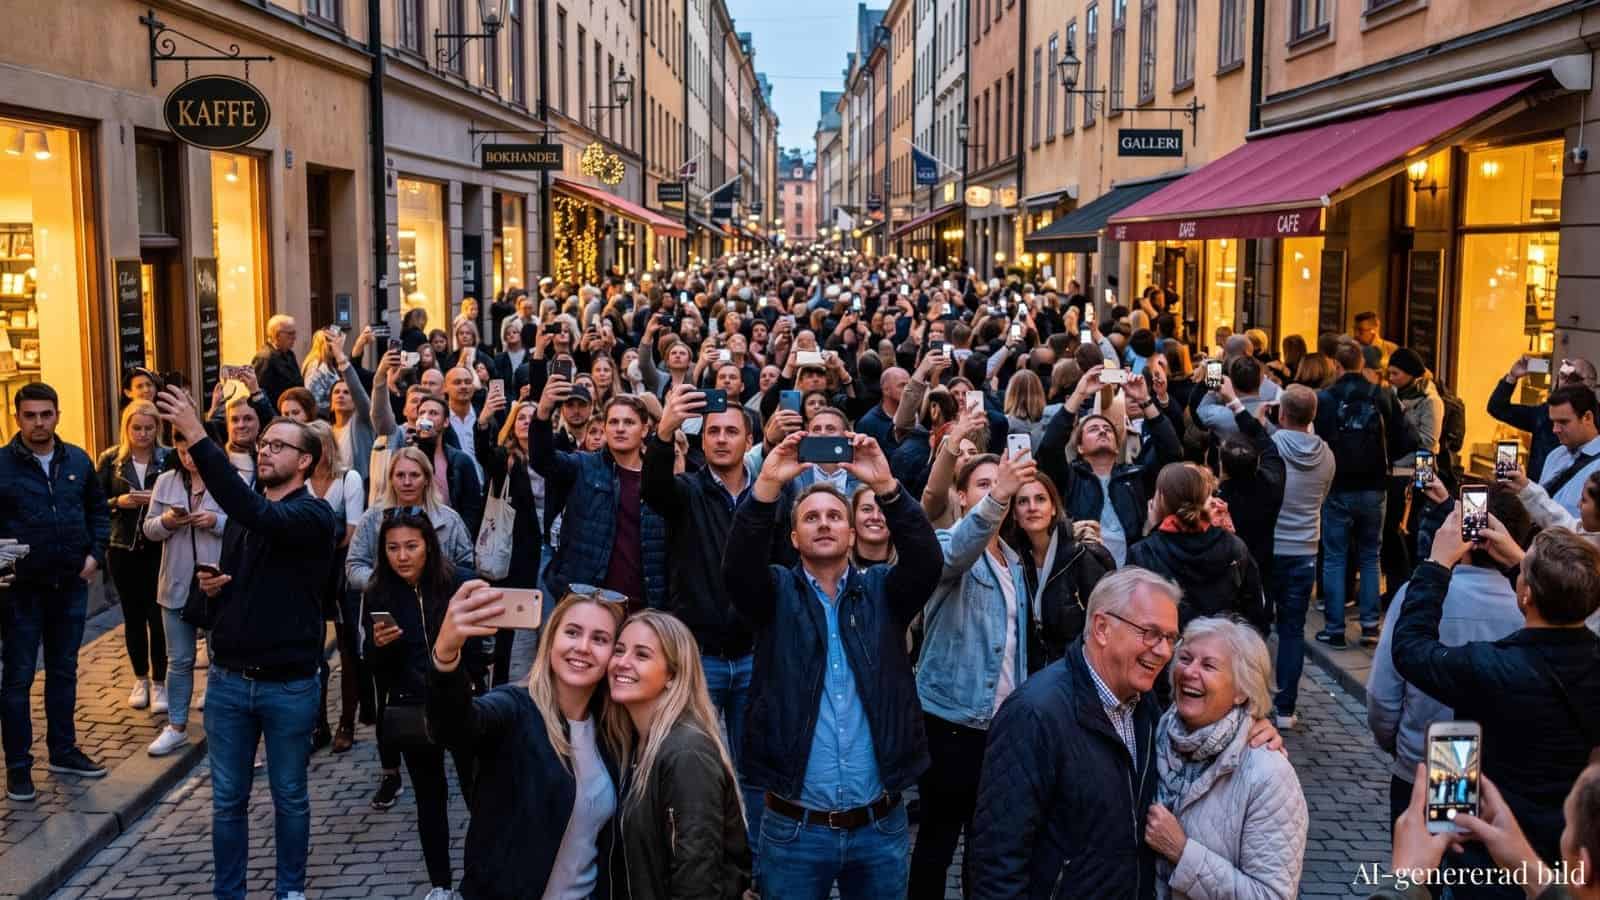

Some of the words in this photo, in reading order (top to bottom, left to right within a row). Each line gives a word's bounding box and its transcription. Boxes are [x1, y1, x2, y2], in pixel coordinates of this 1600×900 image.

[177, 99, 257, 127] KAFFE
[1121, 136, 1180, 149] GALLERI
[486, 151, 559, 163] BOKHANDEL
